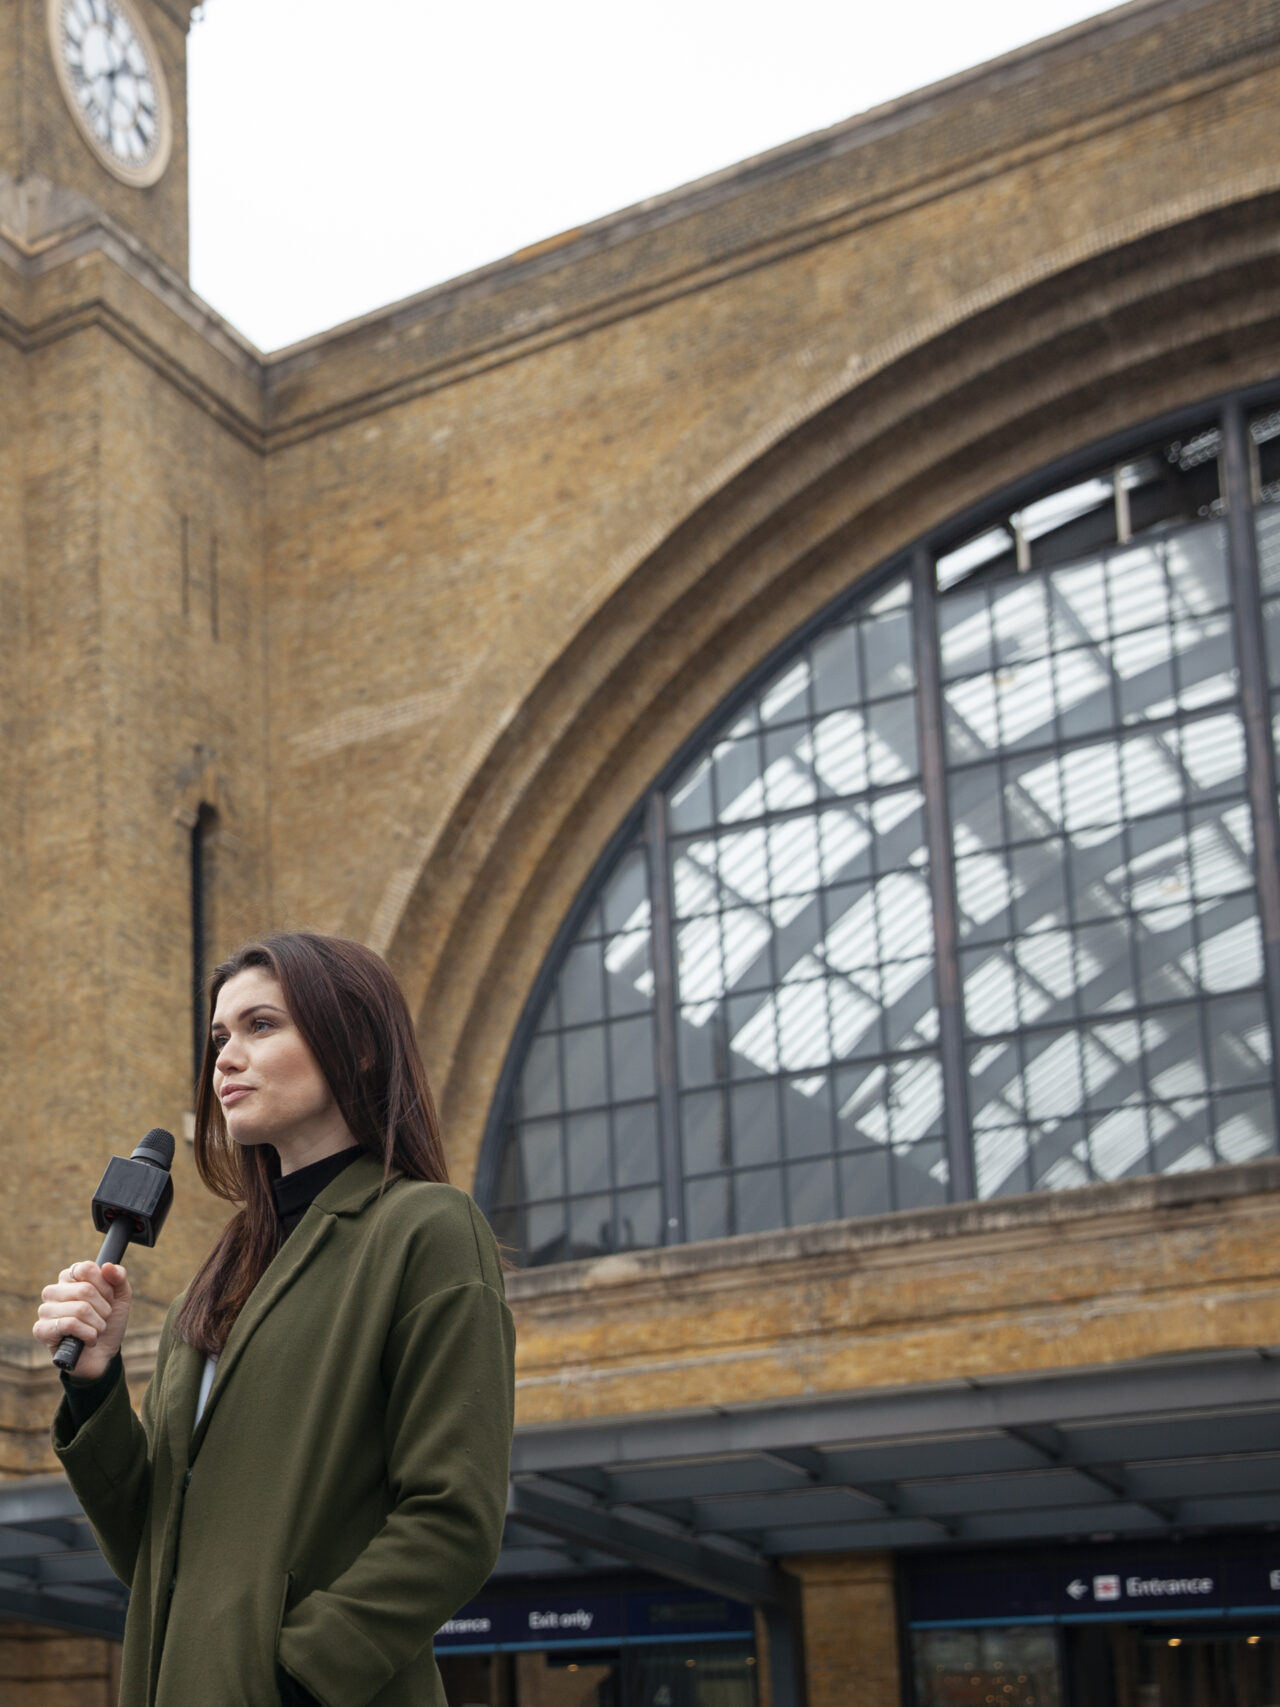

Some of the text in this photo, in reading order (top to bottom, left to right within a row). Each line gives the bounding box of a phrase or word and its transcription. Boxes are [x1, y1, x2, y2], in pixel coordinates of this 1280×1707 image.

[1126, 1576, 1214, 1597] Entrance
[434, 1618, 491, 1635] ntrance
[528, 1609, 593, 1631] Exit only
